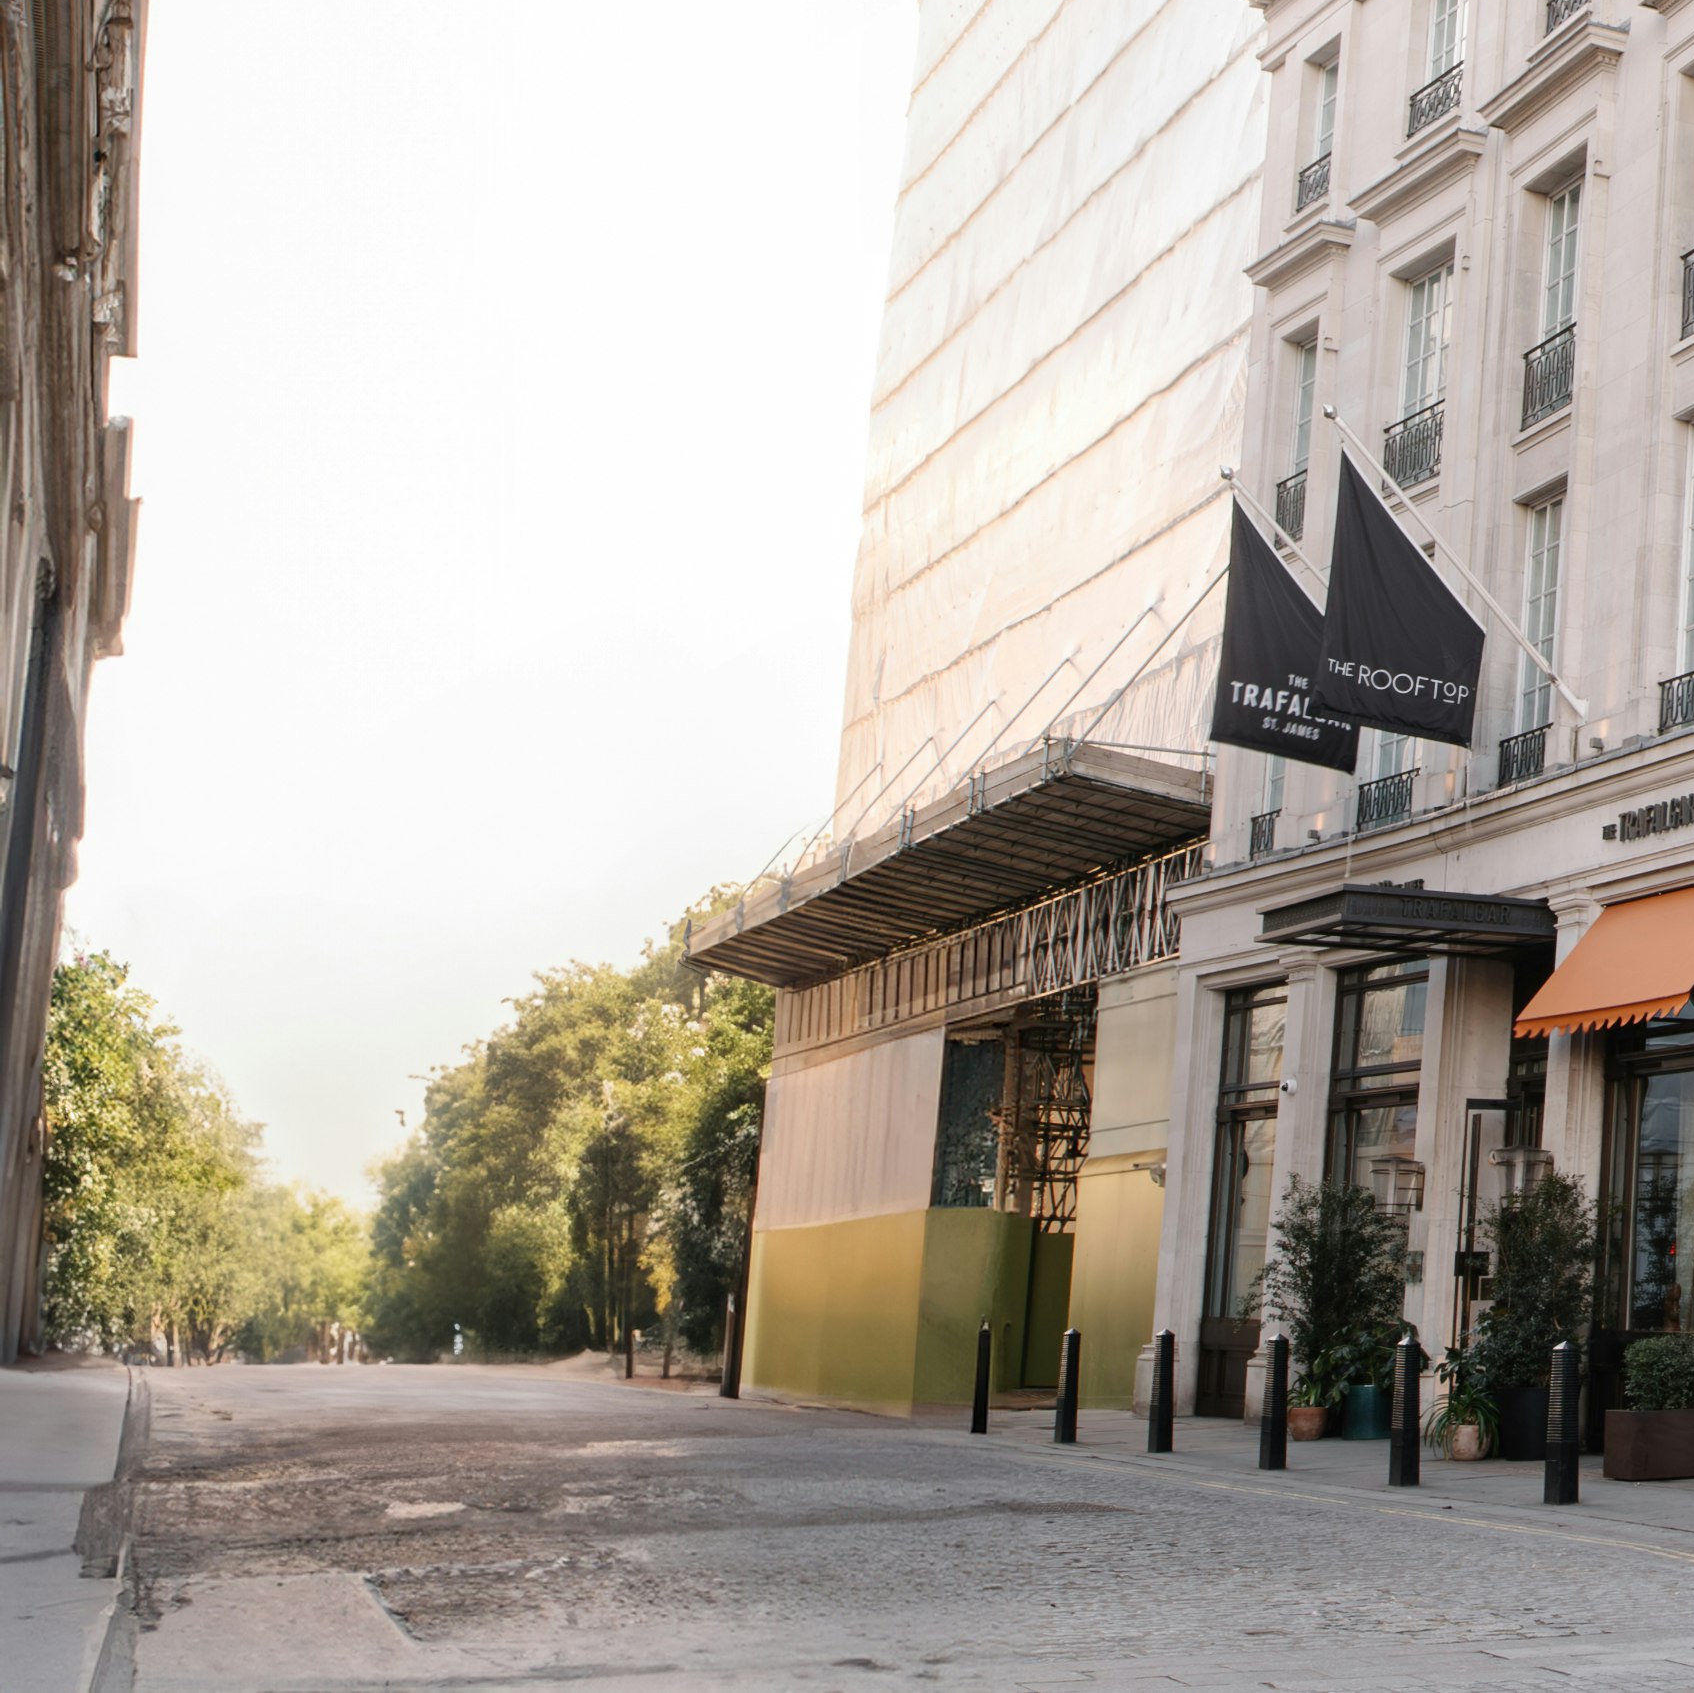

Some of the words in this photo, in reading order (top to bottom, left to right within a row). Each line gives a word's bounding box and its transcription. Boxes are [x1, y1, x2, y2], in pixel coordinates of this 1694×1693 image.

[1287, 673, 1309, 690] THE
[1327, 657, 1356, 677] THE
[1357, 664, 1470, 705] ROOFTOP
[1230, 680, 1352, 731] TRAFAL
[1261, 715, 1280, 731] ST.
[1282, 720, 1321, 741] JAMES
[1399, 898, 1512, 926] TRAFALGAR
